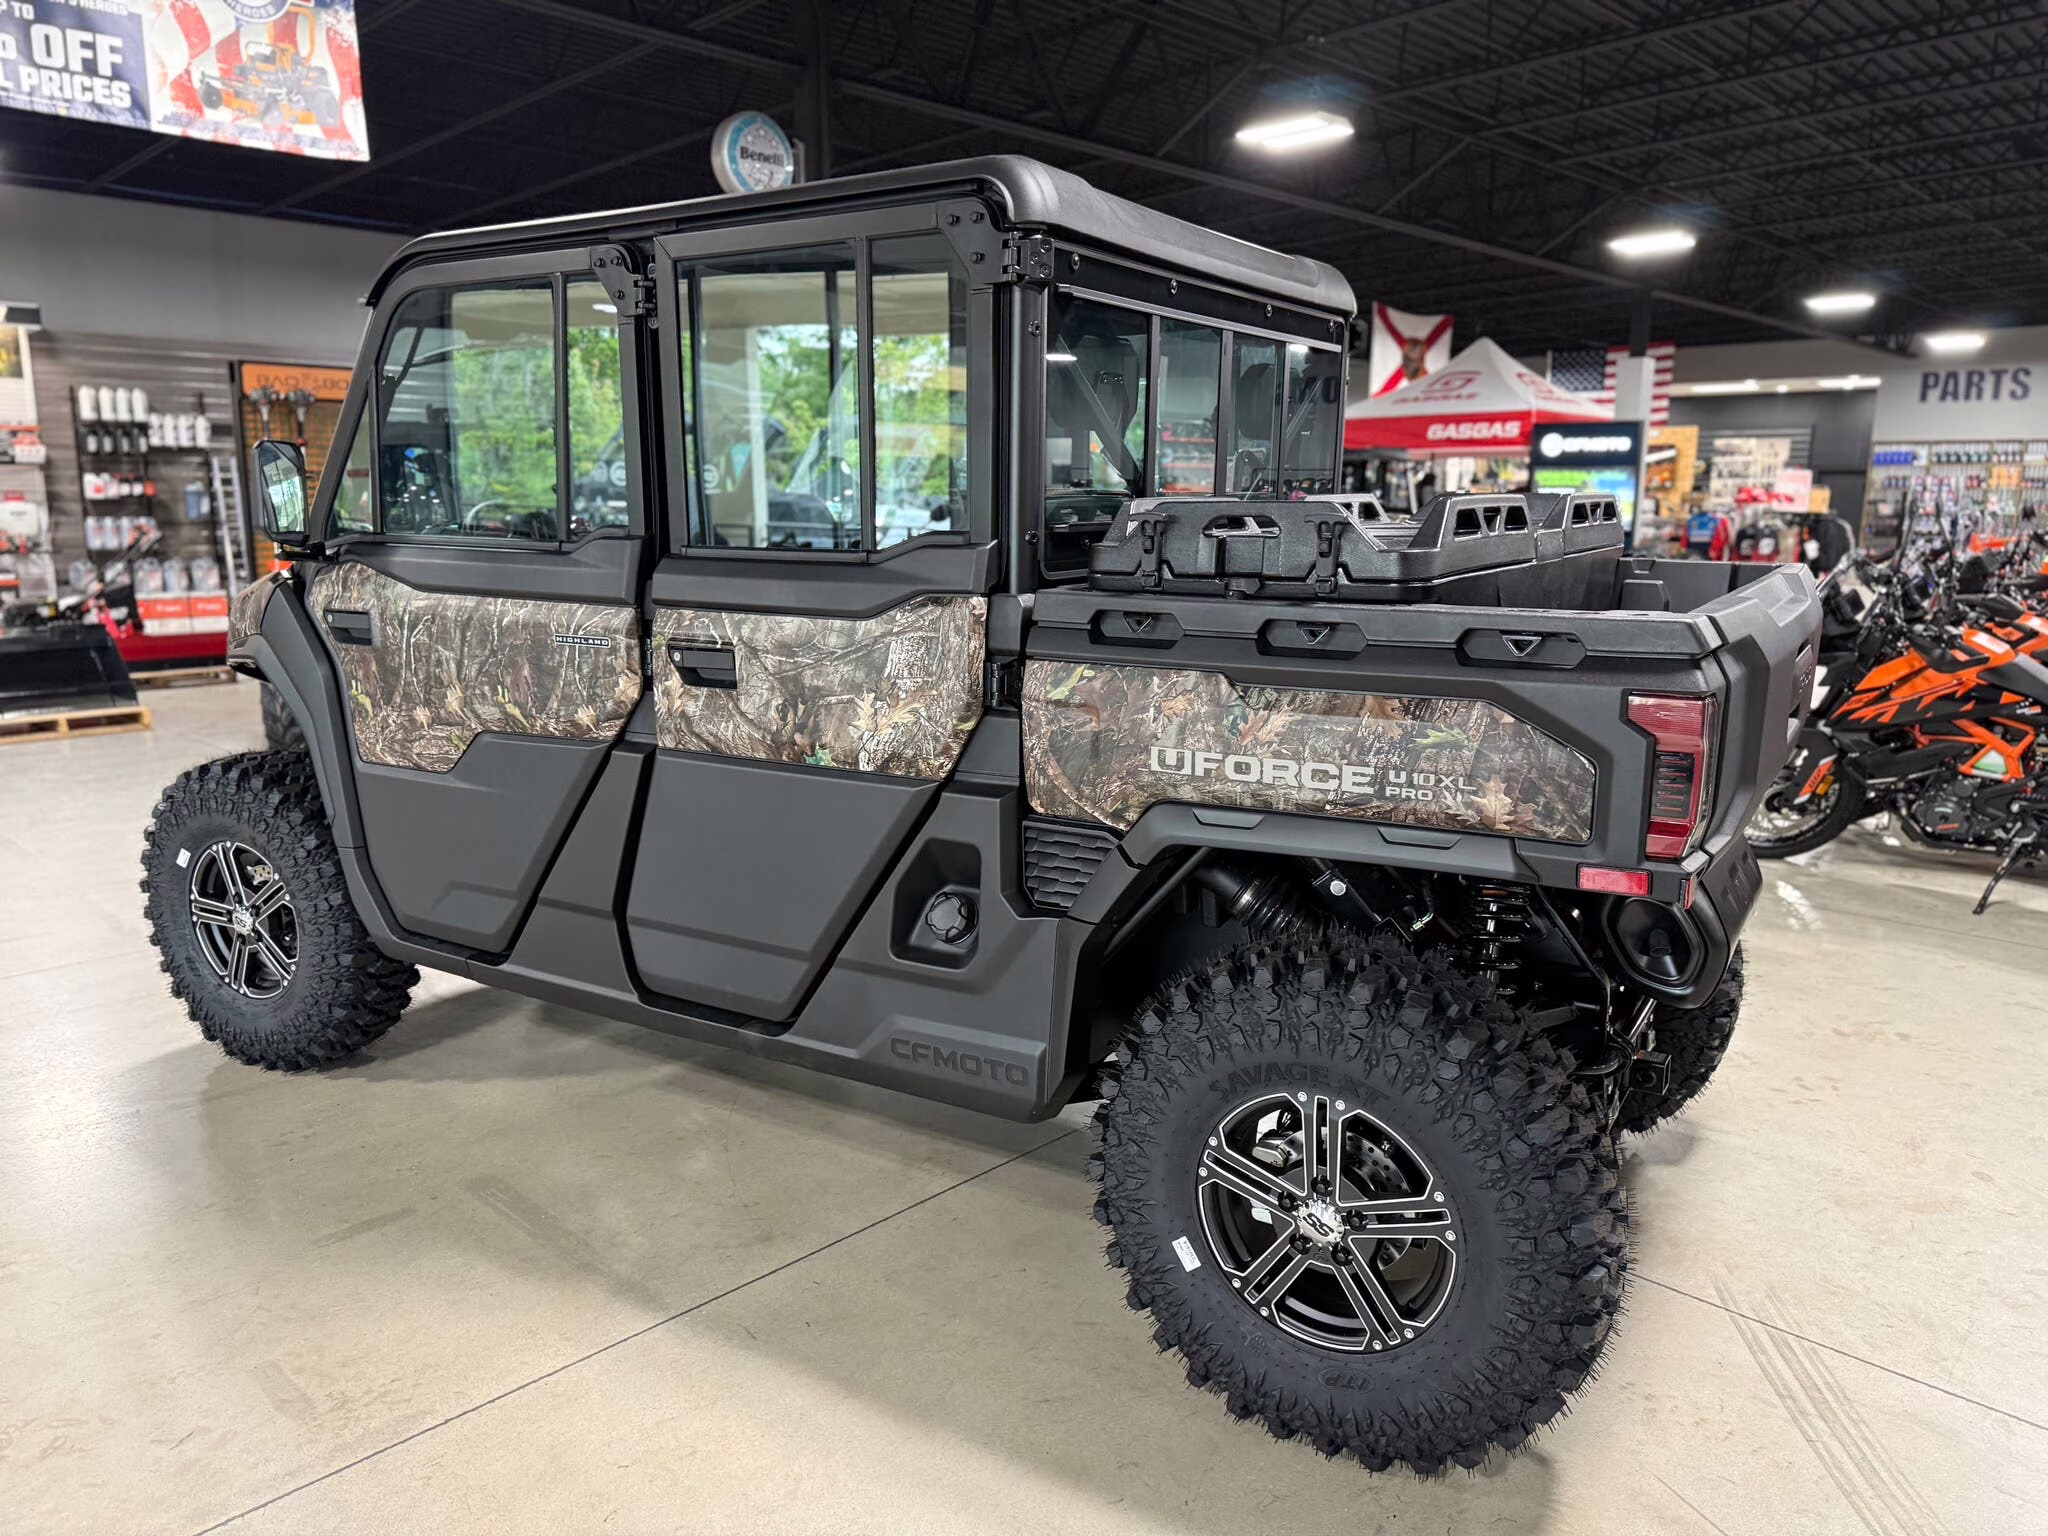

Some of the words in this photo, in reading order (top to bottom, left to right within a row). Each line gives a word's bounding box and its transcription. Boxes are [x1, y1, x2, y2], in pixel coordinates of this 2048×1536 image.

[9, 1, 35, 20] TO
[30, 23, 123, 76] OFF
[18, 64, 132, 109] PRICES
[740, 145, 785, 168] Benelli
[1919, 367, 2031, 402] PARTS
[1425, 420, 1522, 441] GASGAS
[555, 636, 609, 646] HIGHLAND
[1150, 746, 1375, 795] UFORCE
[1385, 786, 1434, 801] PRO
[890, 1037, 1029, 1087] CFMOTO
[1208, 1061, 1330, 1104] SAVAGE
